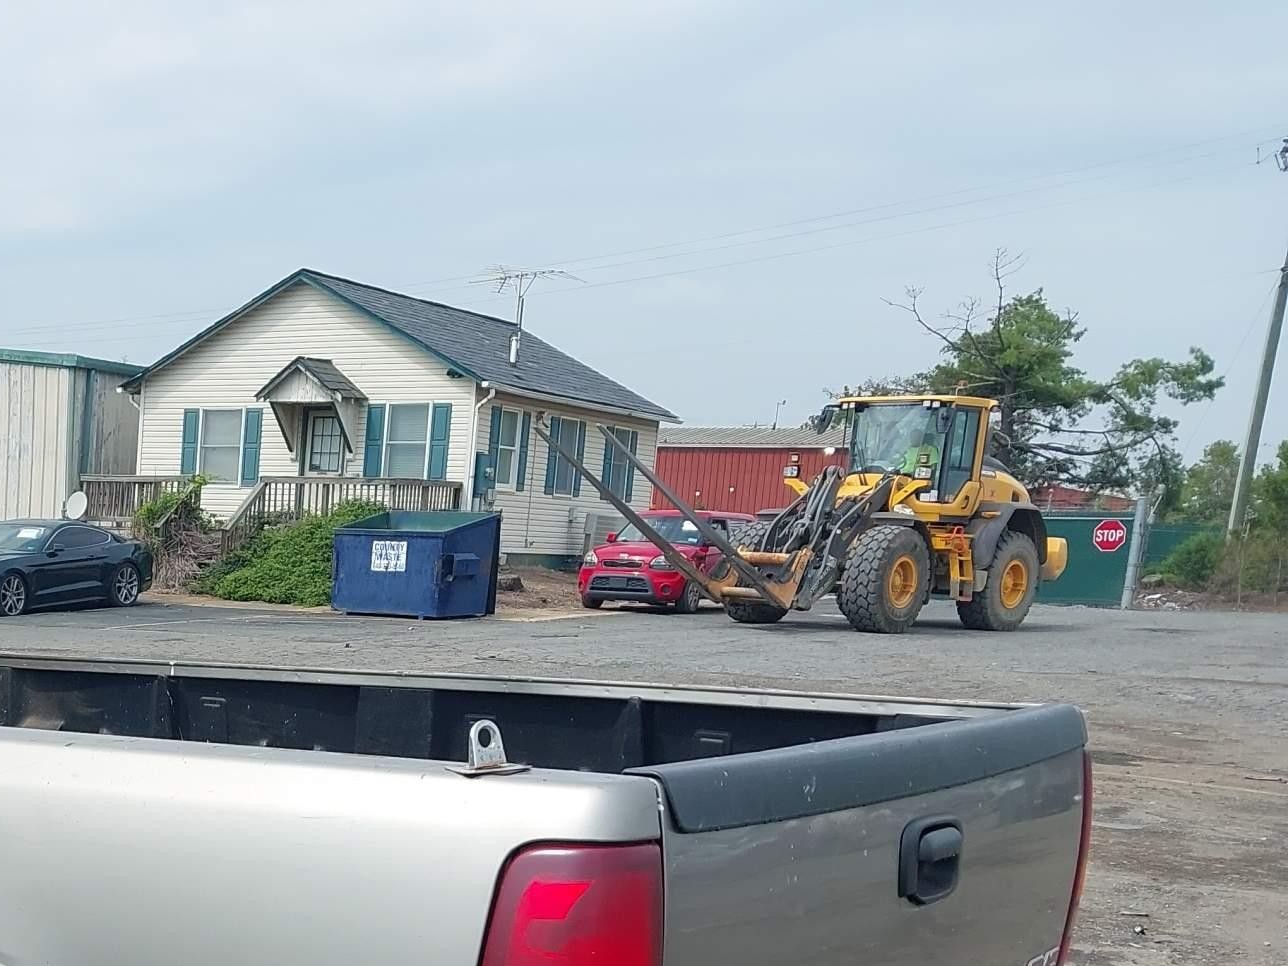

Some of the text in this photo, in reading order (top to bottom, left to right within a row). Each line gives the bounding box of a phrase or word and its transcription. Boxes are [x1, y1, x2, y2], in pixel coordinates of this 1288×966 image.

[1095, 529, 1124, 542] STOP
[374, 543, 405, 551] COUNTY
[374, 551, 401, 561] WASTE
